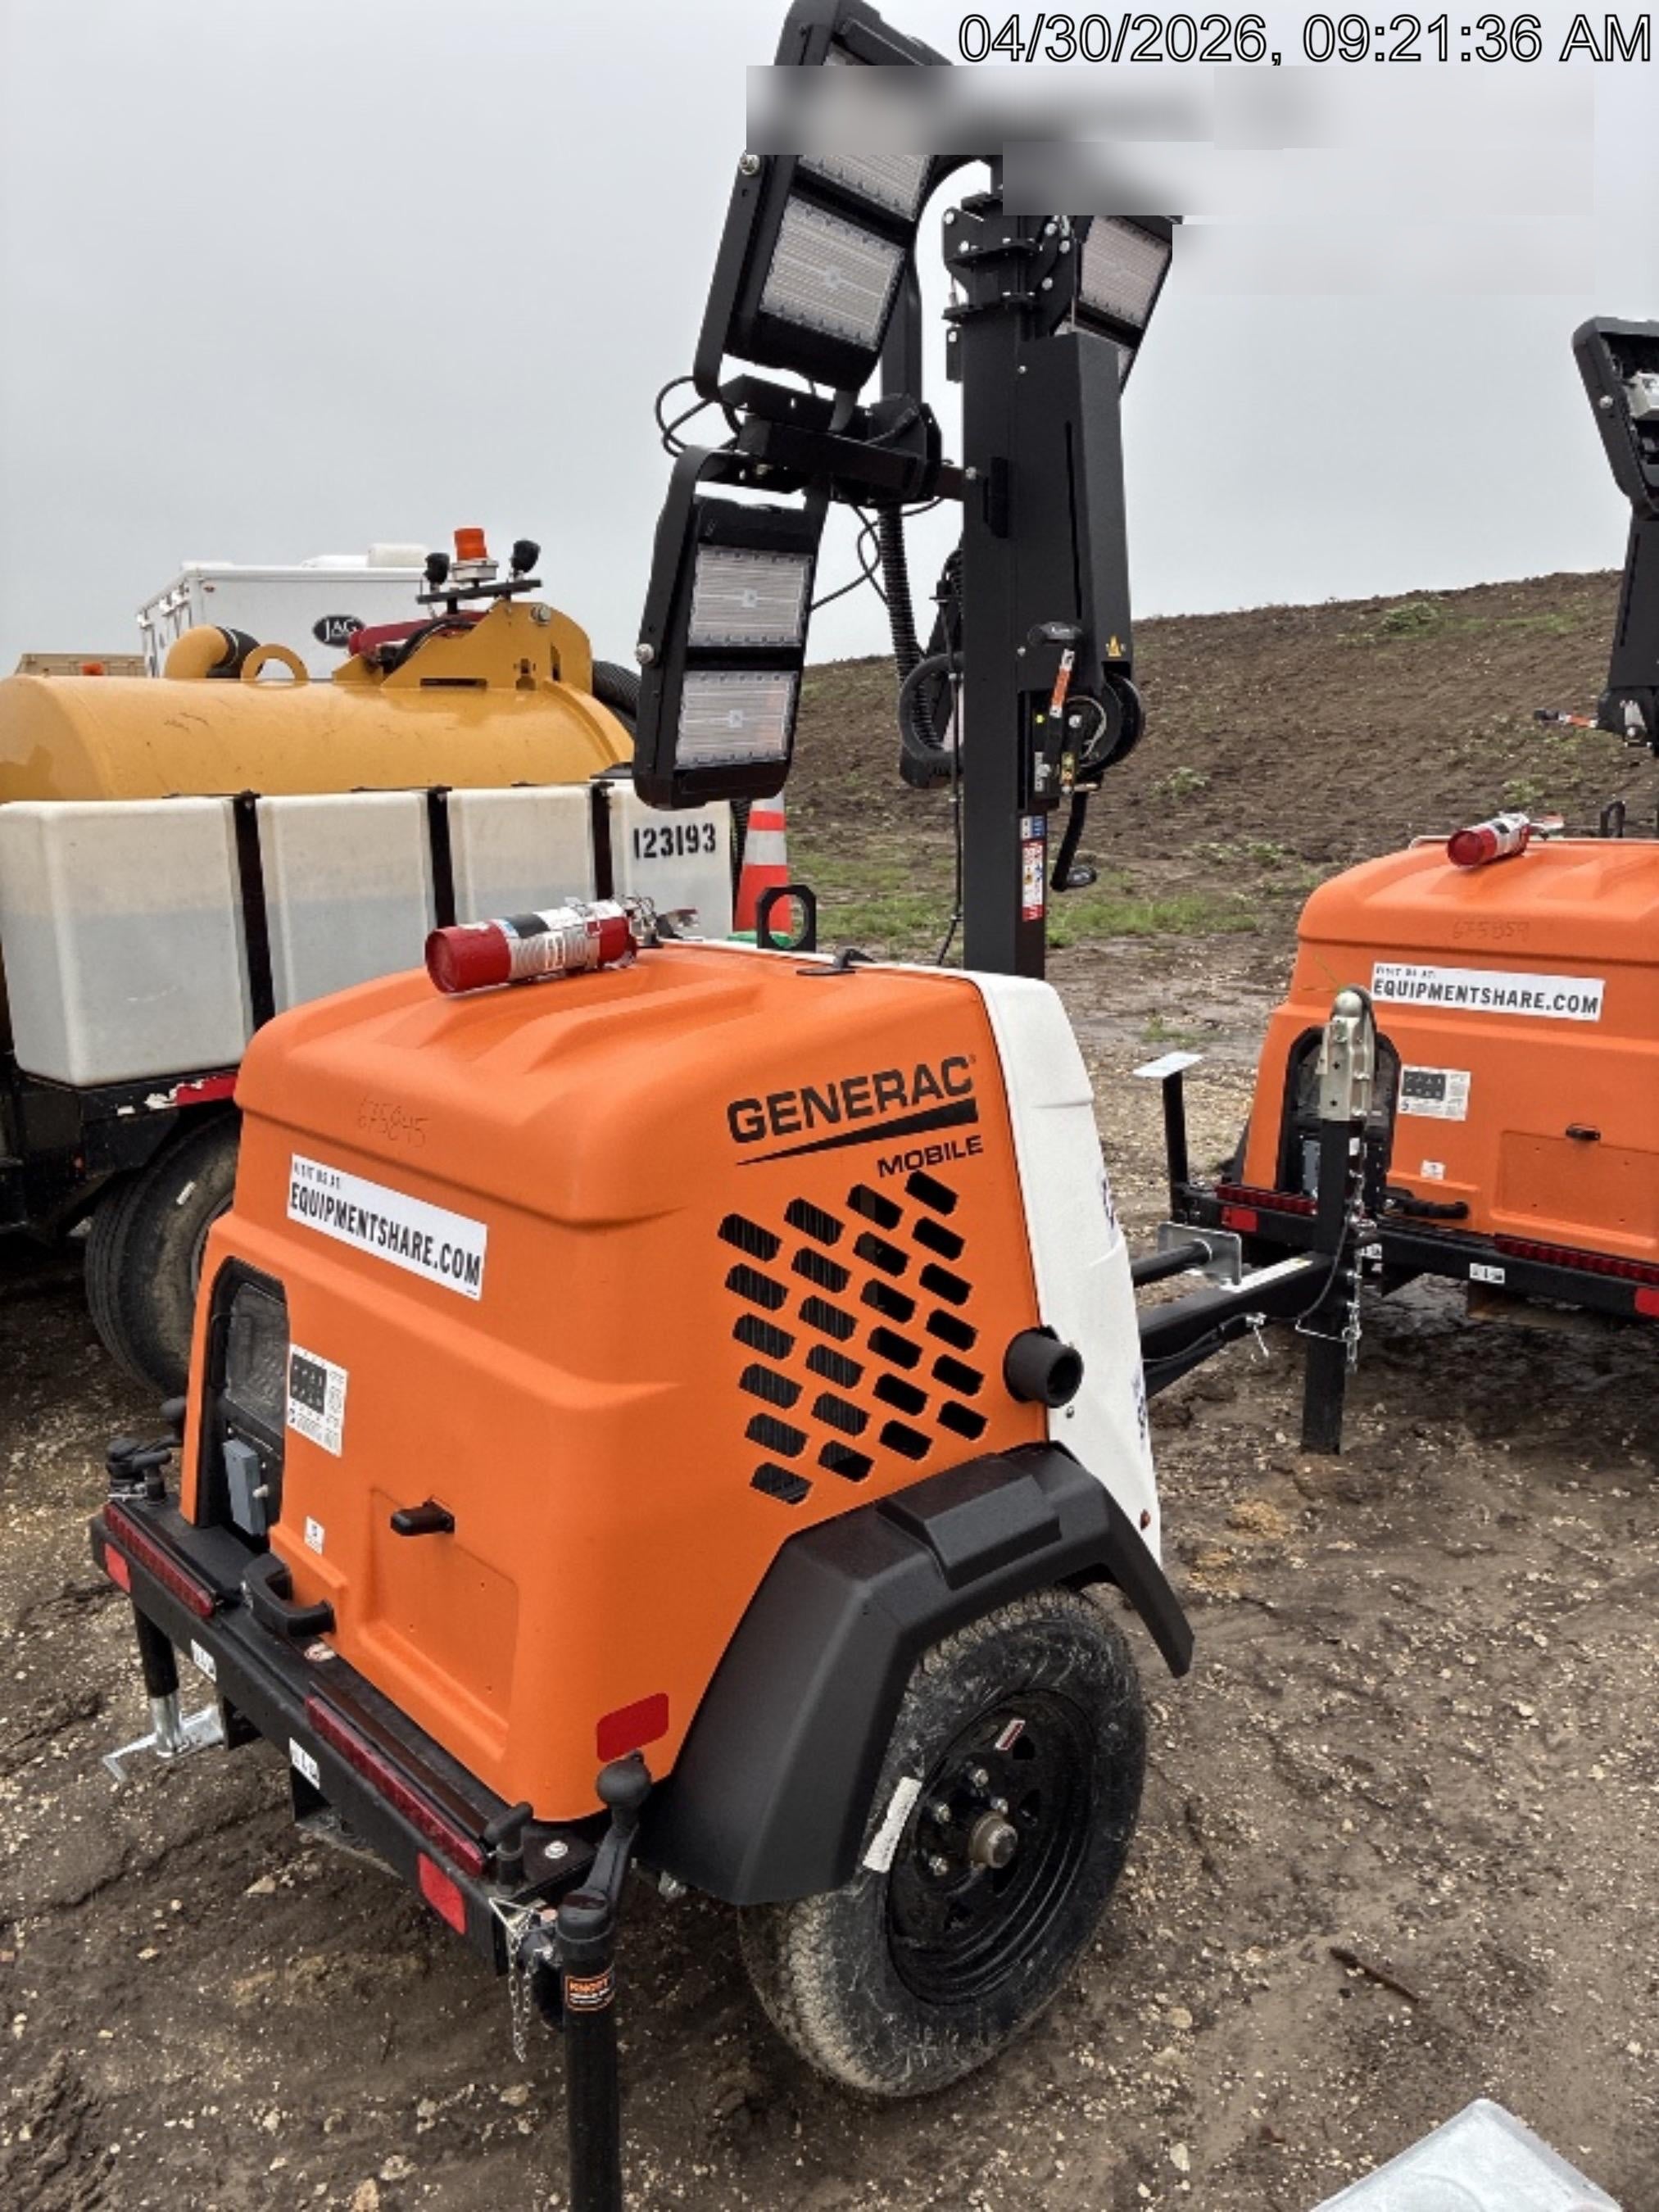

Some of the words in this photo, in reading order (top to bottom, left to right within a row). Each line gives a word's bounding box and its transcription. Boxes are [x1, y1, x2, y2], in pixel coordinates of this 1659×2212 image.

[633, 823, 716, 860] 123193
[1373, 978, 1598, 1014] EQUIPMENTSHARE.COM
[727, 1056, 973, 1144] GENERAC
[877, 1135, 984, 1178] MOBILE
[290, 1181, 481, 1286] EQUIPMENTSHARE.COM
